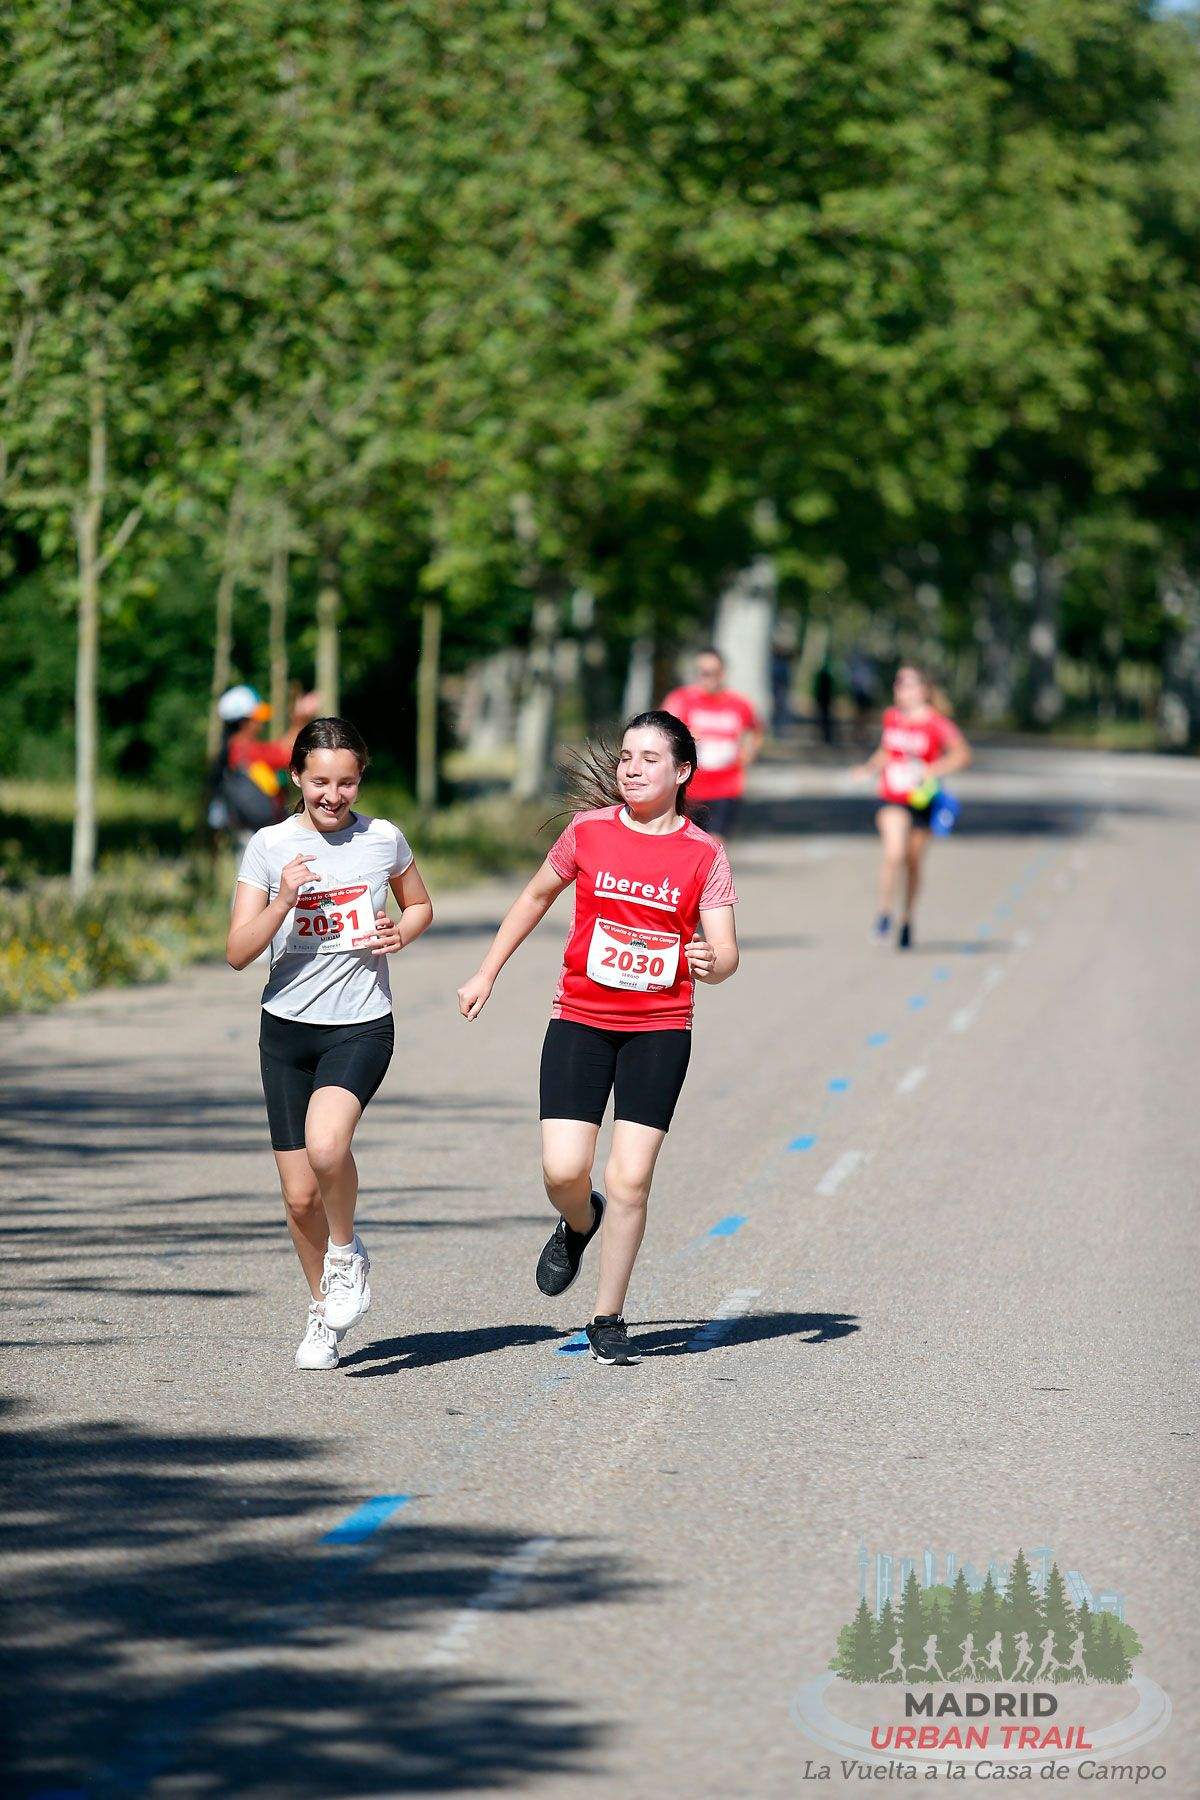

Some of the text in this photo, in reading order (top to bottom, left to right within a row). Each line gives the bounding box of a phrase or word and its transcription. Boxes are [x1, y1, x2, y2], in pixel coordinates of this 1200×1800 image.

[595, 871, 681, 905] Iberext
[296, 910, 359, 936] 2031
[659, 936, 676, 945] Campo
[601, 946, 665, 977] 2030
